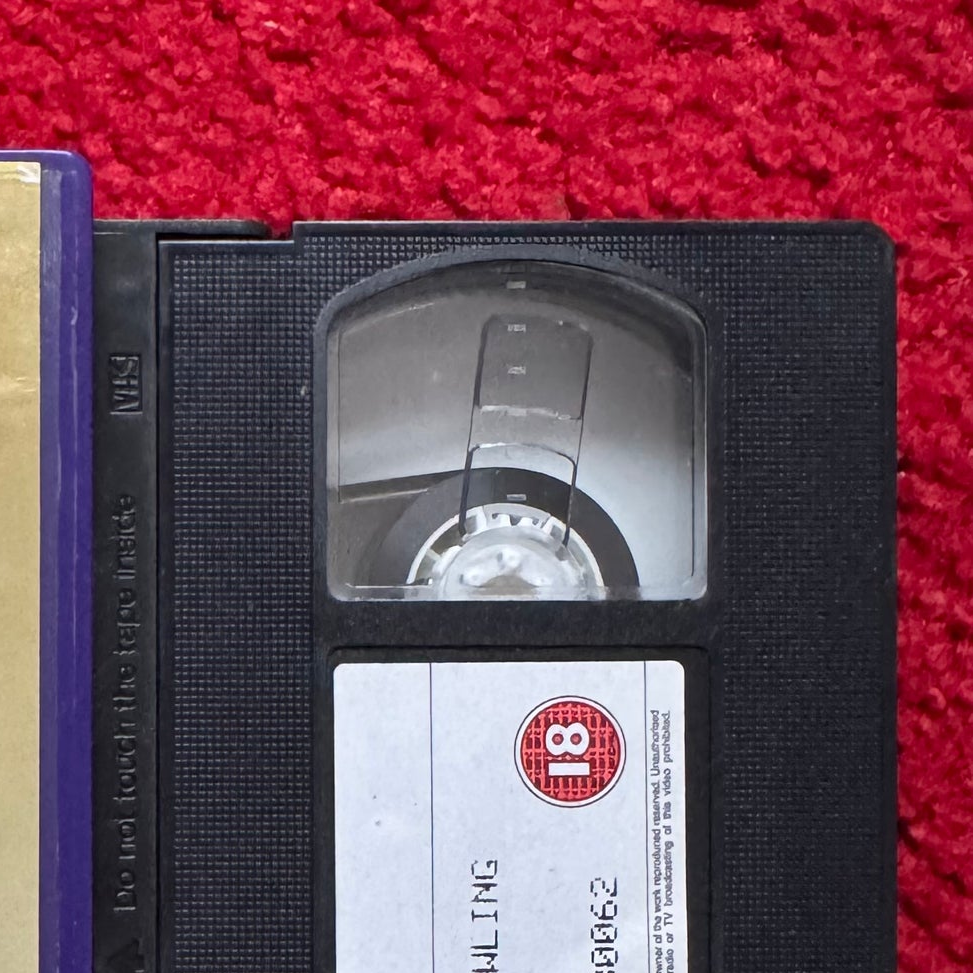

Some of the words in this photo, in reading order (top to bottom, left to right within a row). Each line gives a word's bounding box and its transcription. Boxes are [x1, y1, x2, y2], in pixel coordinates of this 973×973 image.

[110, 353, 144, 413] VHS
[112, 495, 137, 581] inside
[112, 589, 141, 655] tape
[112, 663, 137, 712] the
[113, 721, 136, 800] touch
[544, 721, 591, 776] 18
[661, 767, 671, 795] video
[661, 800, 672, 819] this
[111, 814, 136, 859] not
[662, 824, 672, 834] of
[662, 839, 675, 905] broadcasting
[113, 871, 136, 911] Do
[652, 887, 662, 912] work
[652, 914, 663, 931] the
[664, 911, 674, 925] TV
[652, 933, 663, 943] of
[665, 931, 674, 942] or
[664, 947, 675, 973] radio
